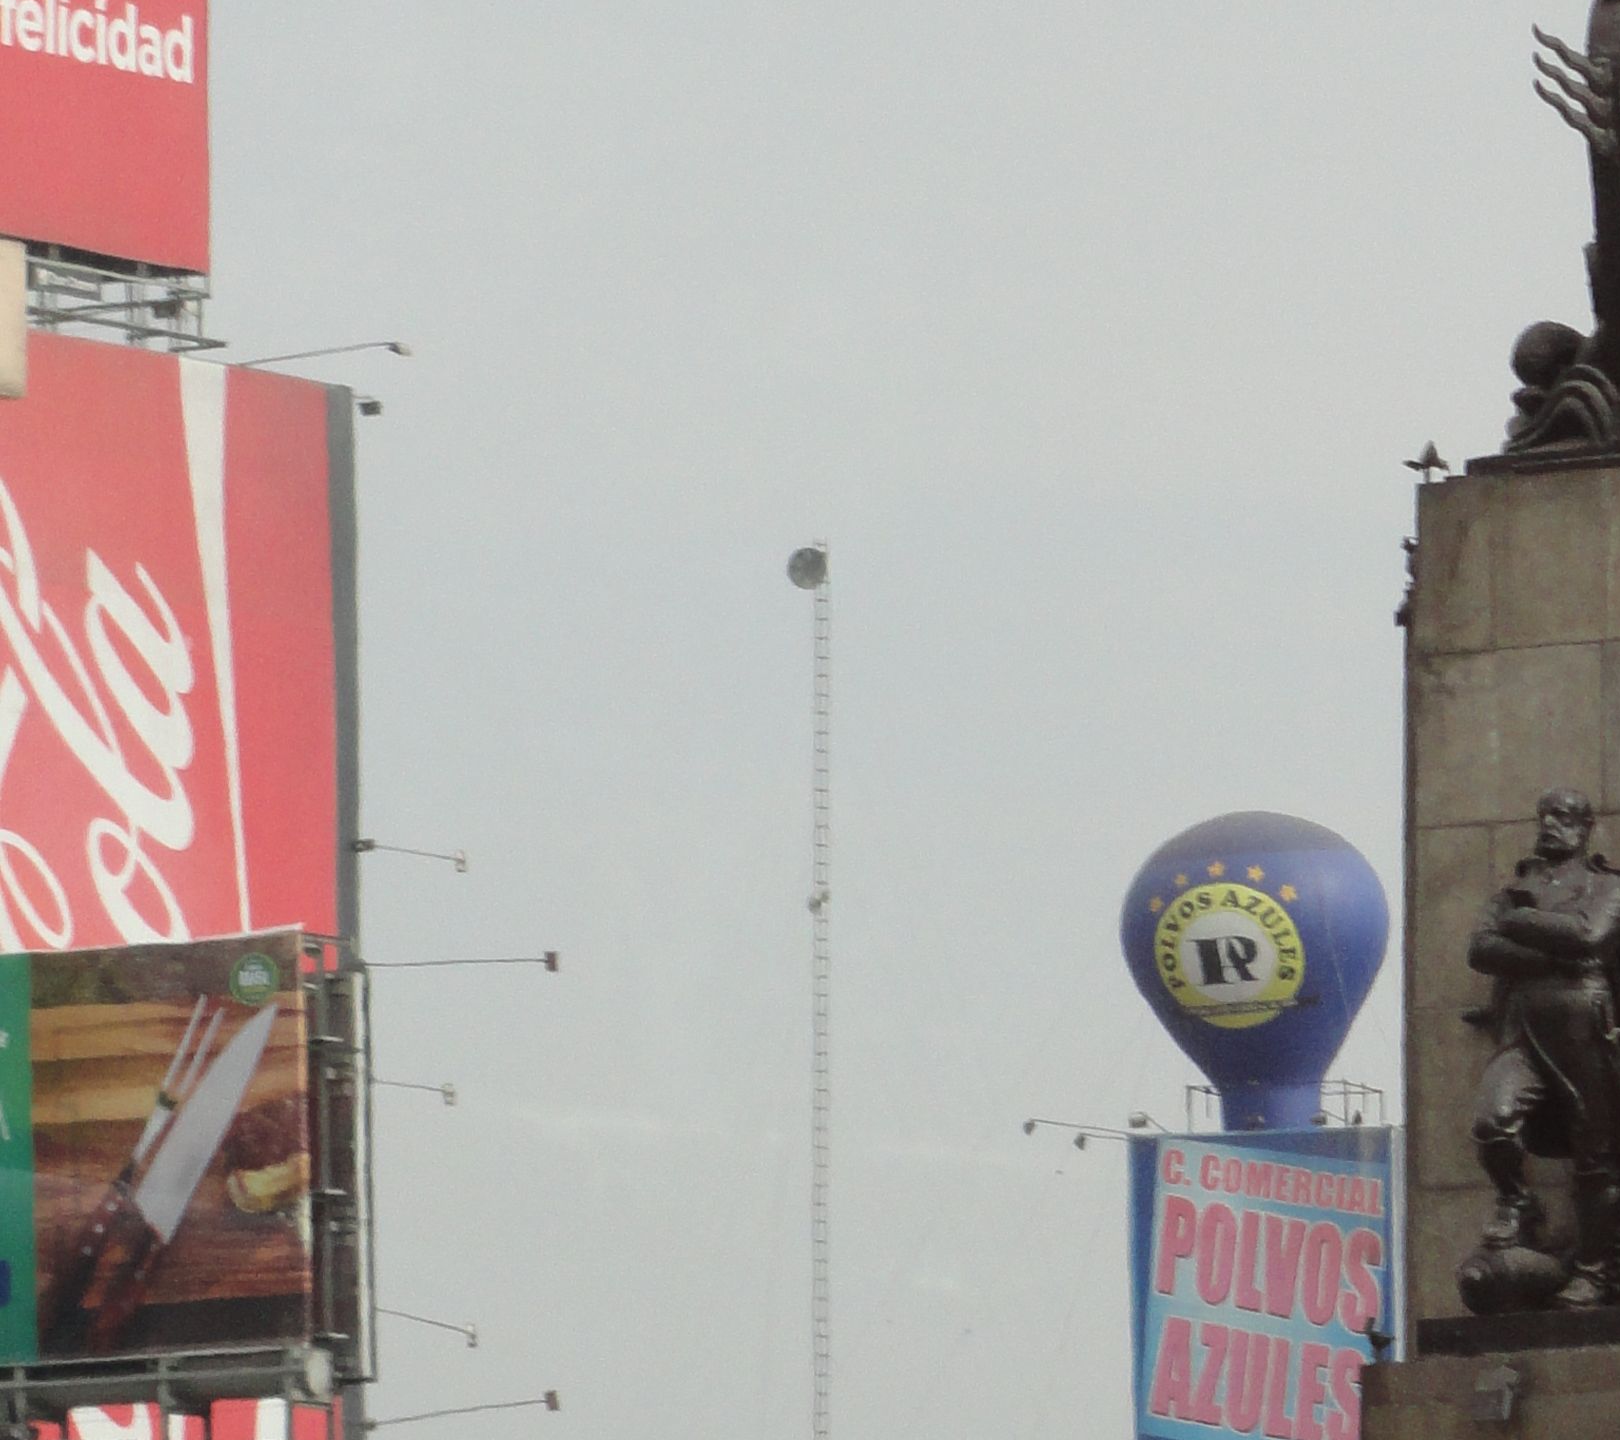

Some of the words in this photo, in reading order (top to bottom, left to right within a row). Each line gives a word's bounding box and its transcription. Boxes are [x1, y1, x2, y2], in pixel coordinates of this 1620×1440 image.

[1160, 890, 1212, 990] POLVOS
[1220, 889, 1297, 982] AZULES
[1161, 1148, 1192, 1187] C.
[1200, 1153, 1384, 1218] COMERCIAL
[1154, 1192, 1383, 1336] POLVOS
